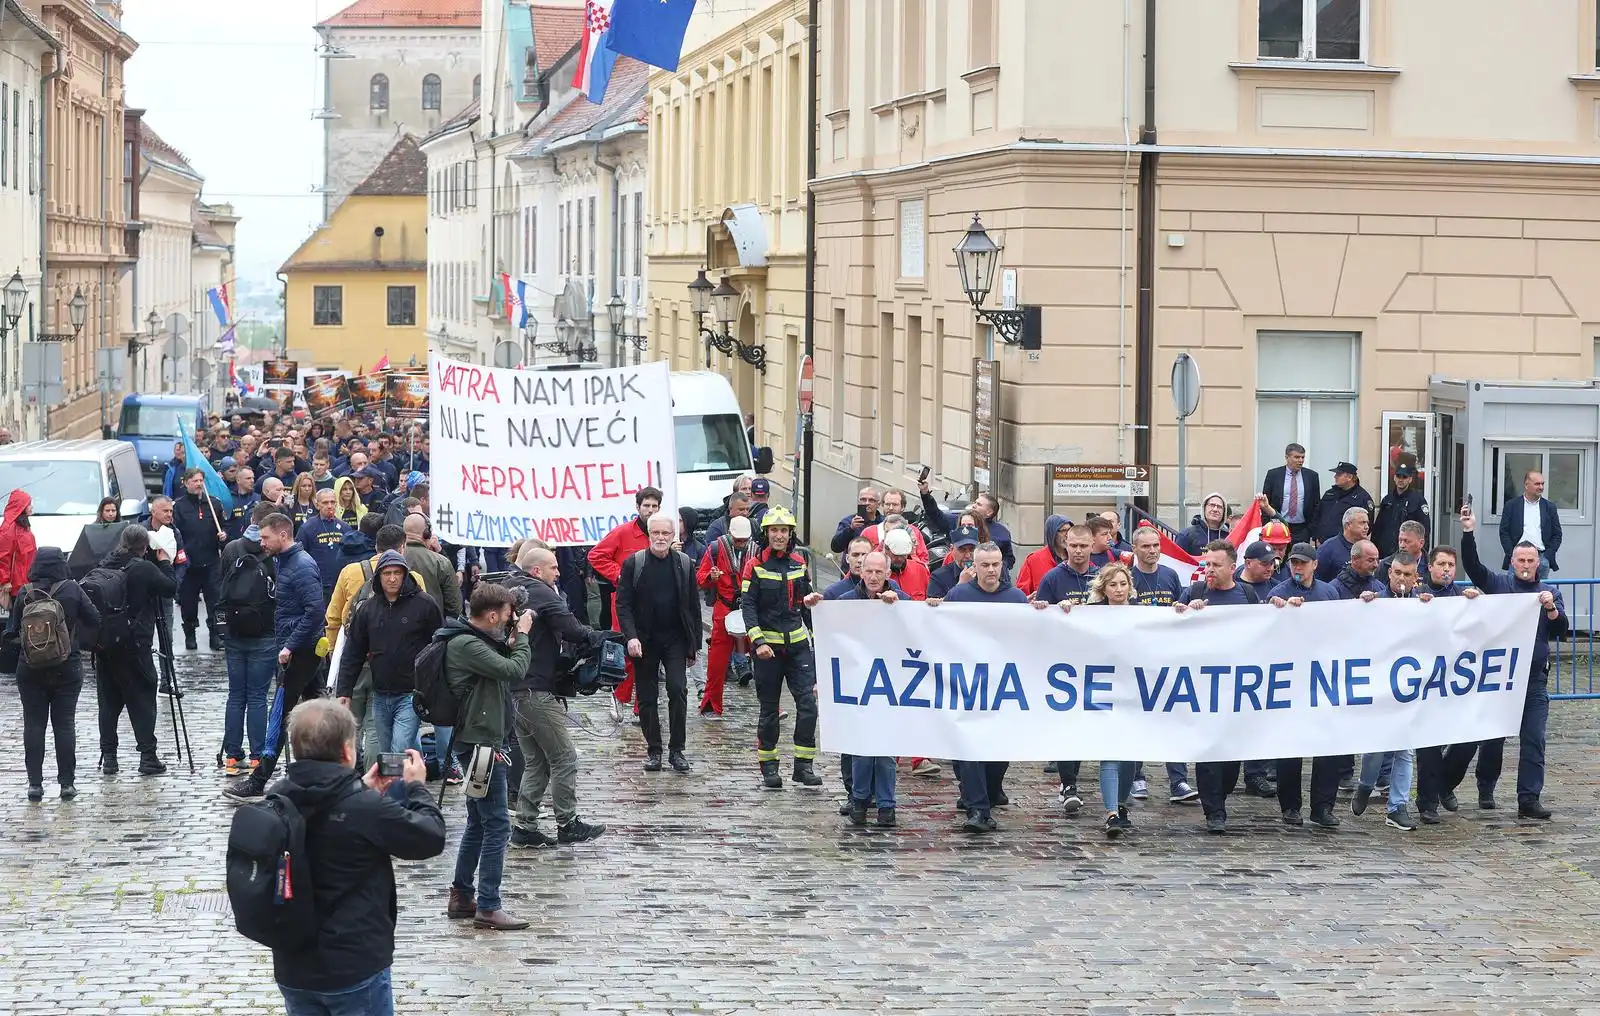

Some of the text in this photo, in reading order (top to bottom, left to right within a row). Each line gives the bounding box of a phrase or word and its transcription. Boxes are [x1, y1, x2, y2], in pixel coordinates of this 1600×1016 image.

[437, 361, 645, 406] VATRA NAM IPAK
[440, 404, 639, 449] NIJE NAJVEĆI
[461, 460, 662, 500] NEPRIJATELJ!
[831, 647, 1519, 713] LAŽIMA SE VATRE NE GASE!
